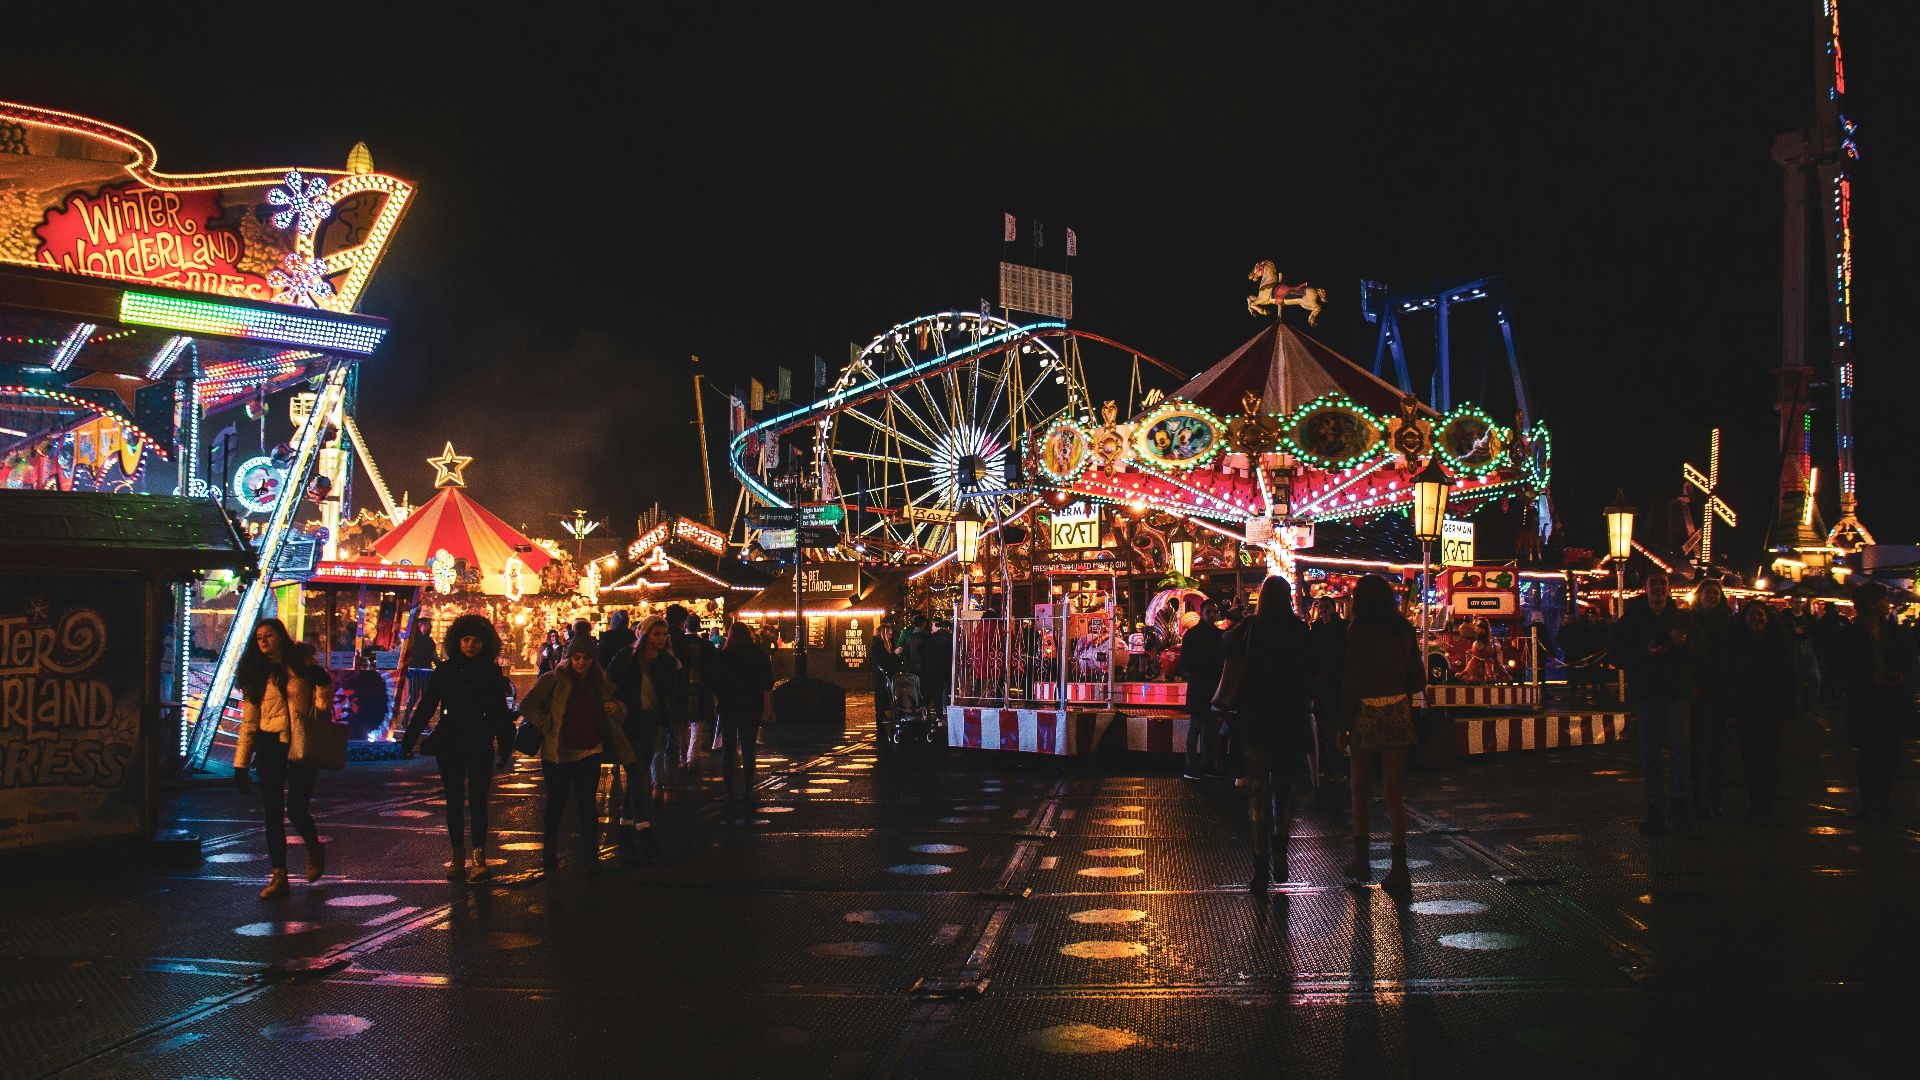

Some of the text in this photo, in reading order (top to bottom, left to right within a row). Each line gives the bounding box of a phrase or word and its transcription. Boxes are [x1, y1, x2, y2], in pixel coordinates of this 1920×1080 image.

[912, 508, 954, 521] Bart
[1054, 521, 1097, 546] KRAFT
[1443, 523, 1473, 535] GERMAN
[1443, 539, 1472, 563] KRAFT
[809, 570, 820, 581] GET
[808, 580, 832, 592] LOADED
[0, 738, 133, 788] RESS
